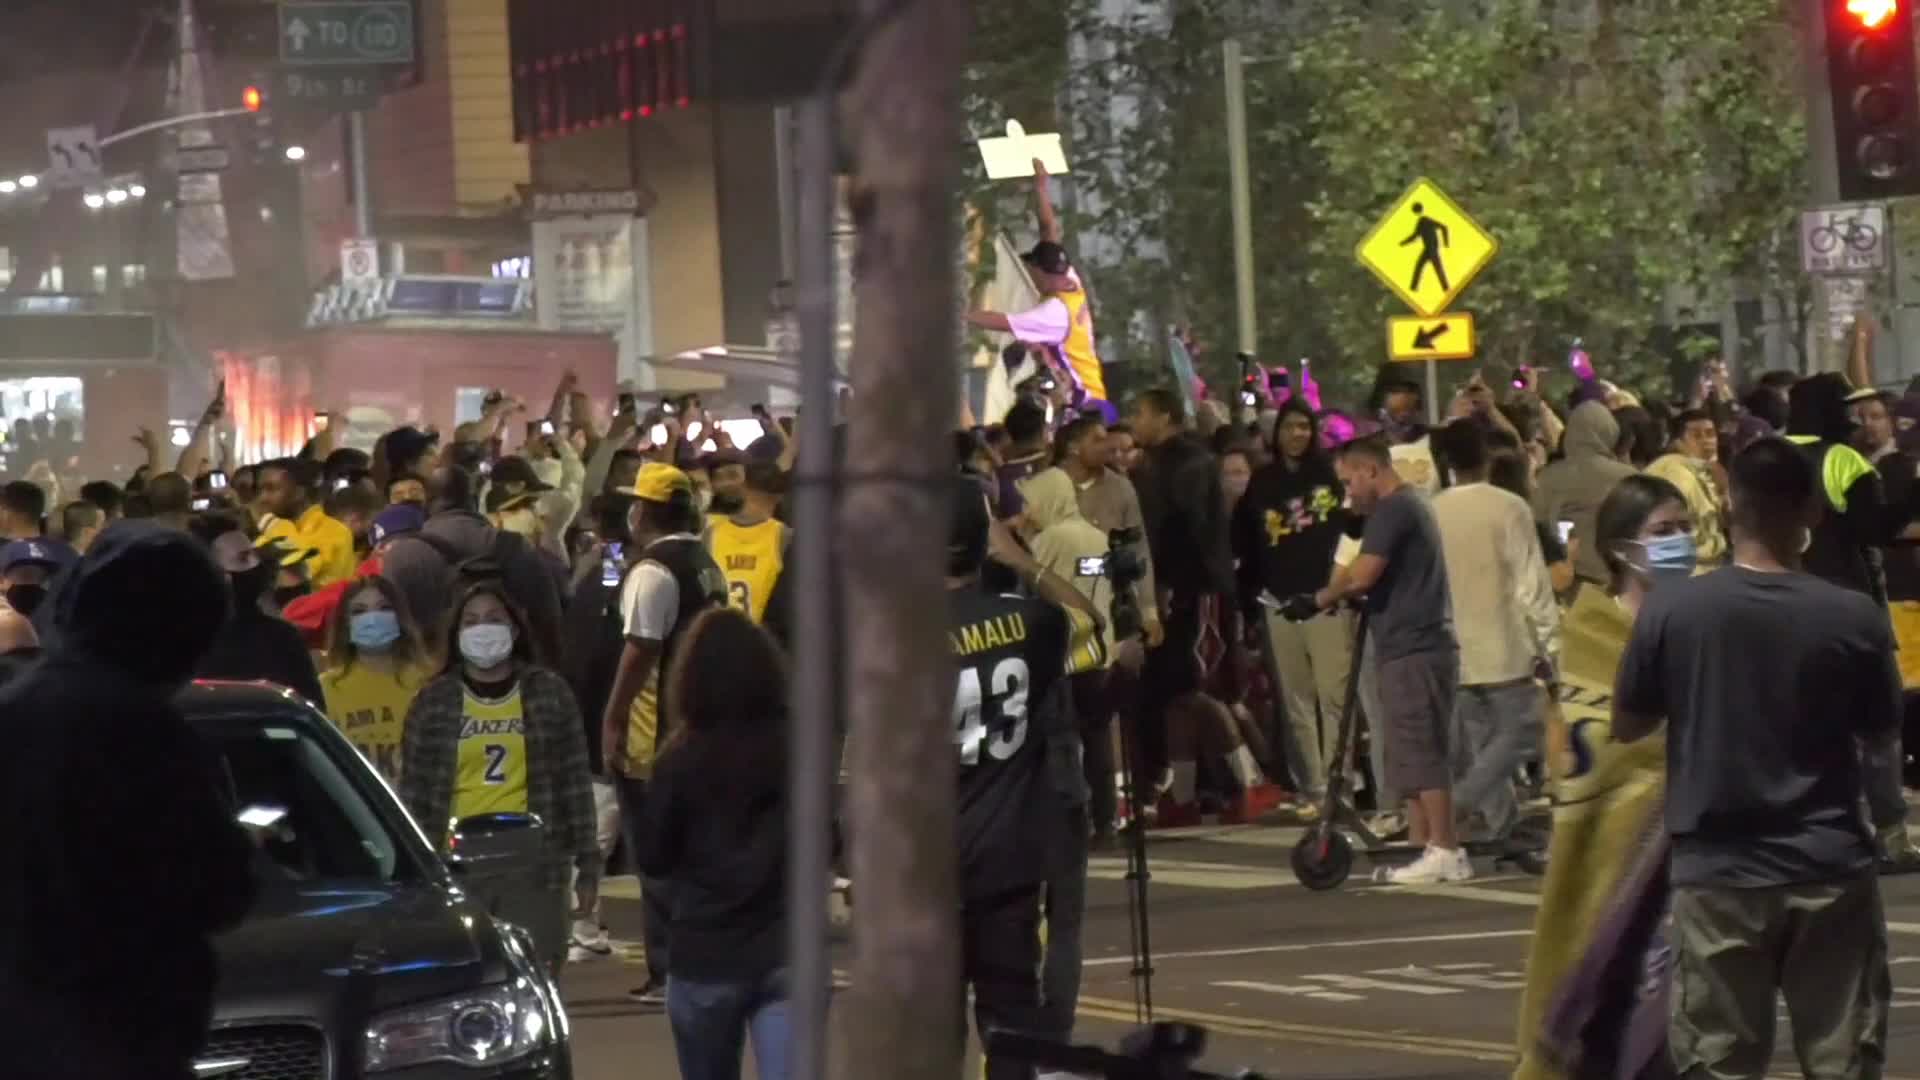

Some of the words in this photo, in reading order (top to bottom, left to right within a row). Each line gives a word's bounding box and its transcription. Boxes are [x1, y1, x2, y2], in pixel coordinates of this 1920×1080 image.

[318, 20, 346, 47] TO
[533, 188, 640, 213] PARKING
[951, 656, 1031, 766] 43
[484, 743, 508, 784] 2
